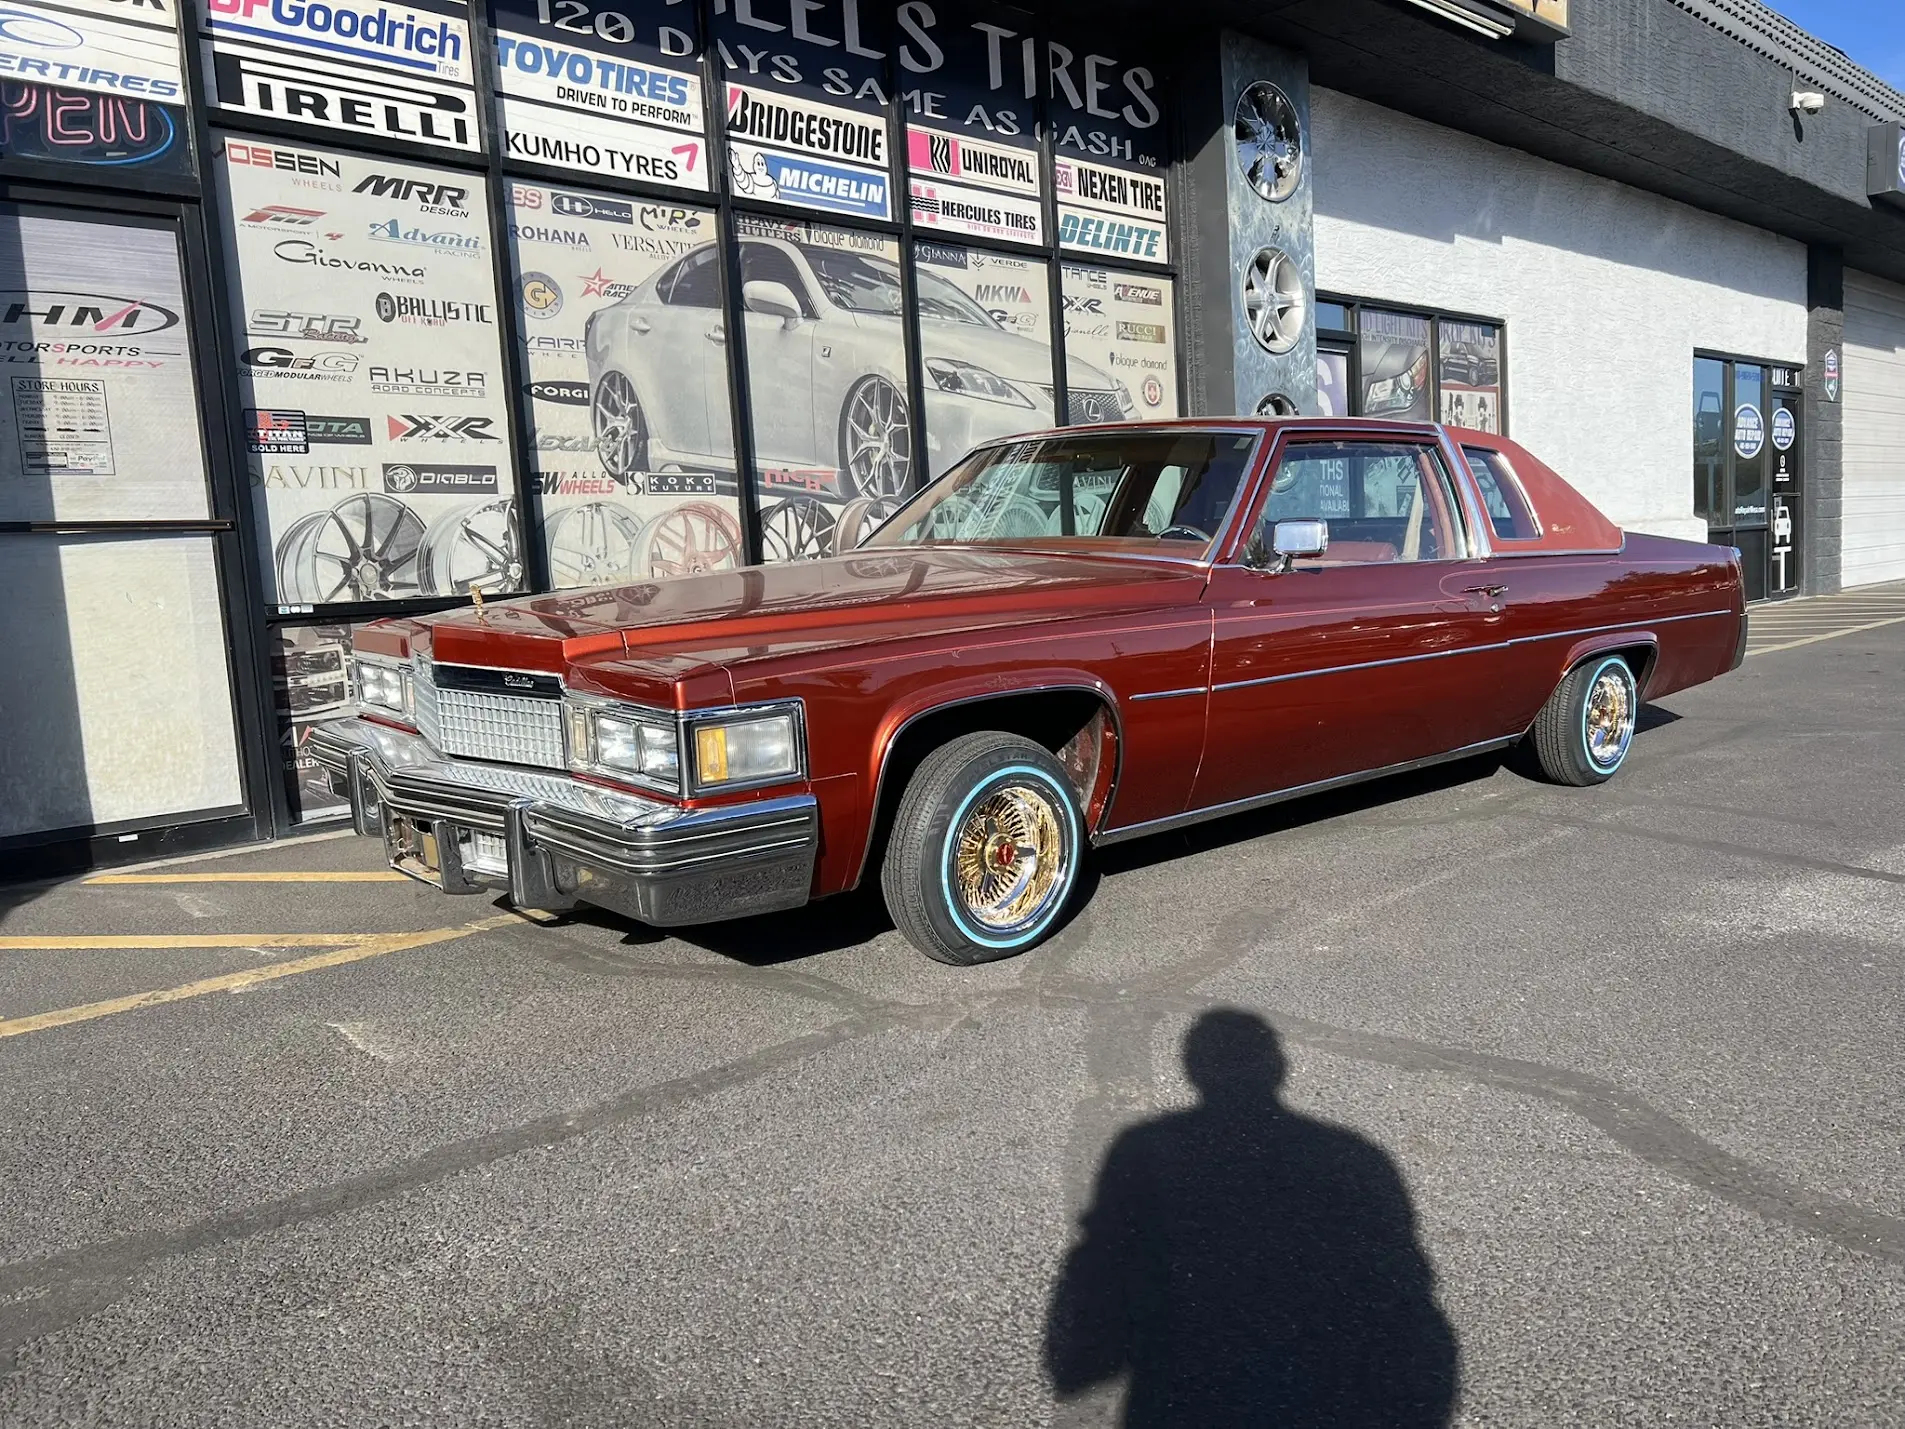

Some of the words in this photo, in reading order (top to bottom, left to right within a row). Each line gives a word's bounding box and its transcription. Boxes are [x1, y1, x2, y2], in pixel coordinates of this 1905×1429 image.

[437, 62, 459, 77] Tires
[493, 36, 593, 85] TOYO
[596, 61, 689, 106] TIRES
[538, 0, 635, 43] 120
[964, 105, 1020, 135] AS
[971, 22, 1159, 128] TIRES
[213, 50, 467, 145] PIRELLI
[556, 86, 607, 109] DRIVEN
[612, 97, 627, 112] TO
[632, 102, 691, 125] PERFORM
[727, 88, 883, 161] BRIDGESTONE
[227, 143, 340, 178] OSSEN
[504, 130, 600, 166] KUMHO
[605, 149, 678, 180] TYRES
[962, 147, 1034, 184] UNIROYAL
[291, 177, 343, 192] WHEELS
[352, 174, 470, 208] MRR
[779, 167, 884, 204] MICHELIN
[1077, 168, 1128, 205] NEXEN
[1129, 178, 1162, 212] TIRE
[420, 205, 470, 219] DESIGN
[594, 207, 632, 218] HELO
[941, 200, 1001, 225] HERCULES
[1004, 211, 1036, 231] TIRES
[368, 219, 481, 249] Advanti
[509, 224, 590, 246] ROHANA
[656, 224, 698, 235] WHEELS
[1060, 214, 1162, 257] DELINTE
[434, 249, 482, 259] RACING
[612, 233, 695, 255] VERSANT
[274, 240, 425, 277] Giovanna
[990, 257, 1028, 269] VERDE
[381, 276, 424, 285] WHEELS
[1062, 266, 1107, 283] TANCE
[397, 295, 492, 323] BALLISTIC
[250, 309, 364, 338] STR
[1118, 322, 1157, 337] RUCCI
[57, 357, 166, 369] HAPPY
[18, 380, 56, 391] STORE
[60, 382, 99, 392] HOURS
[369, 367, 486, 387] AKUZA
[371, 384, 409, 394] ROAD
[415, 386, 486, 397] CONCEPTS
[306, 420, 364, 434] OTA
[252, 445, 279, 453] SOLD
[280, 445, 306, 453] HERE
[419, 473, 496, 484] DIABLO
[560, 479, 615, 495] WHEELS
[650, 477, 713, 485] KOKO
[1073, 475, 1114, 488] AVINI
